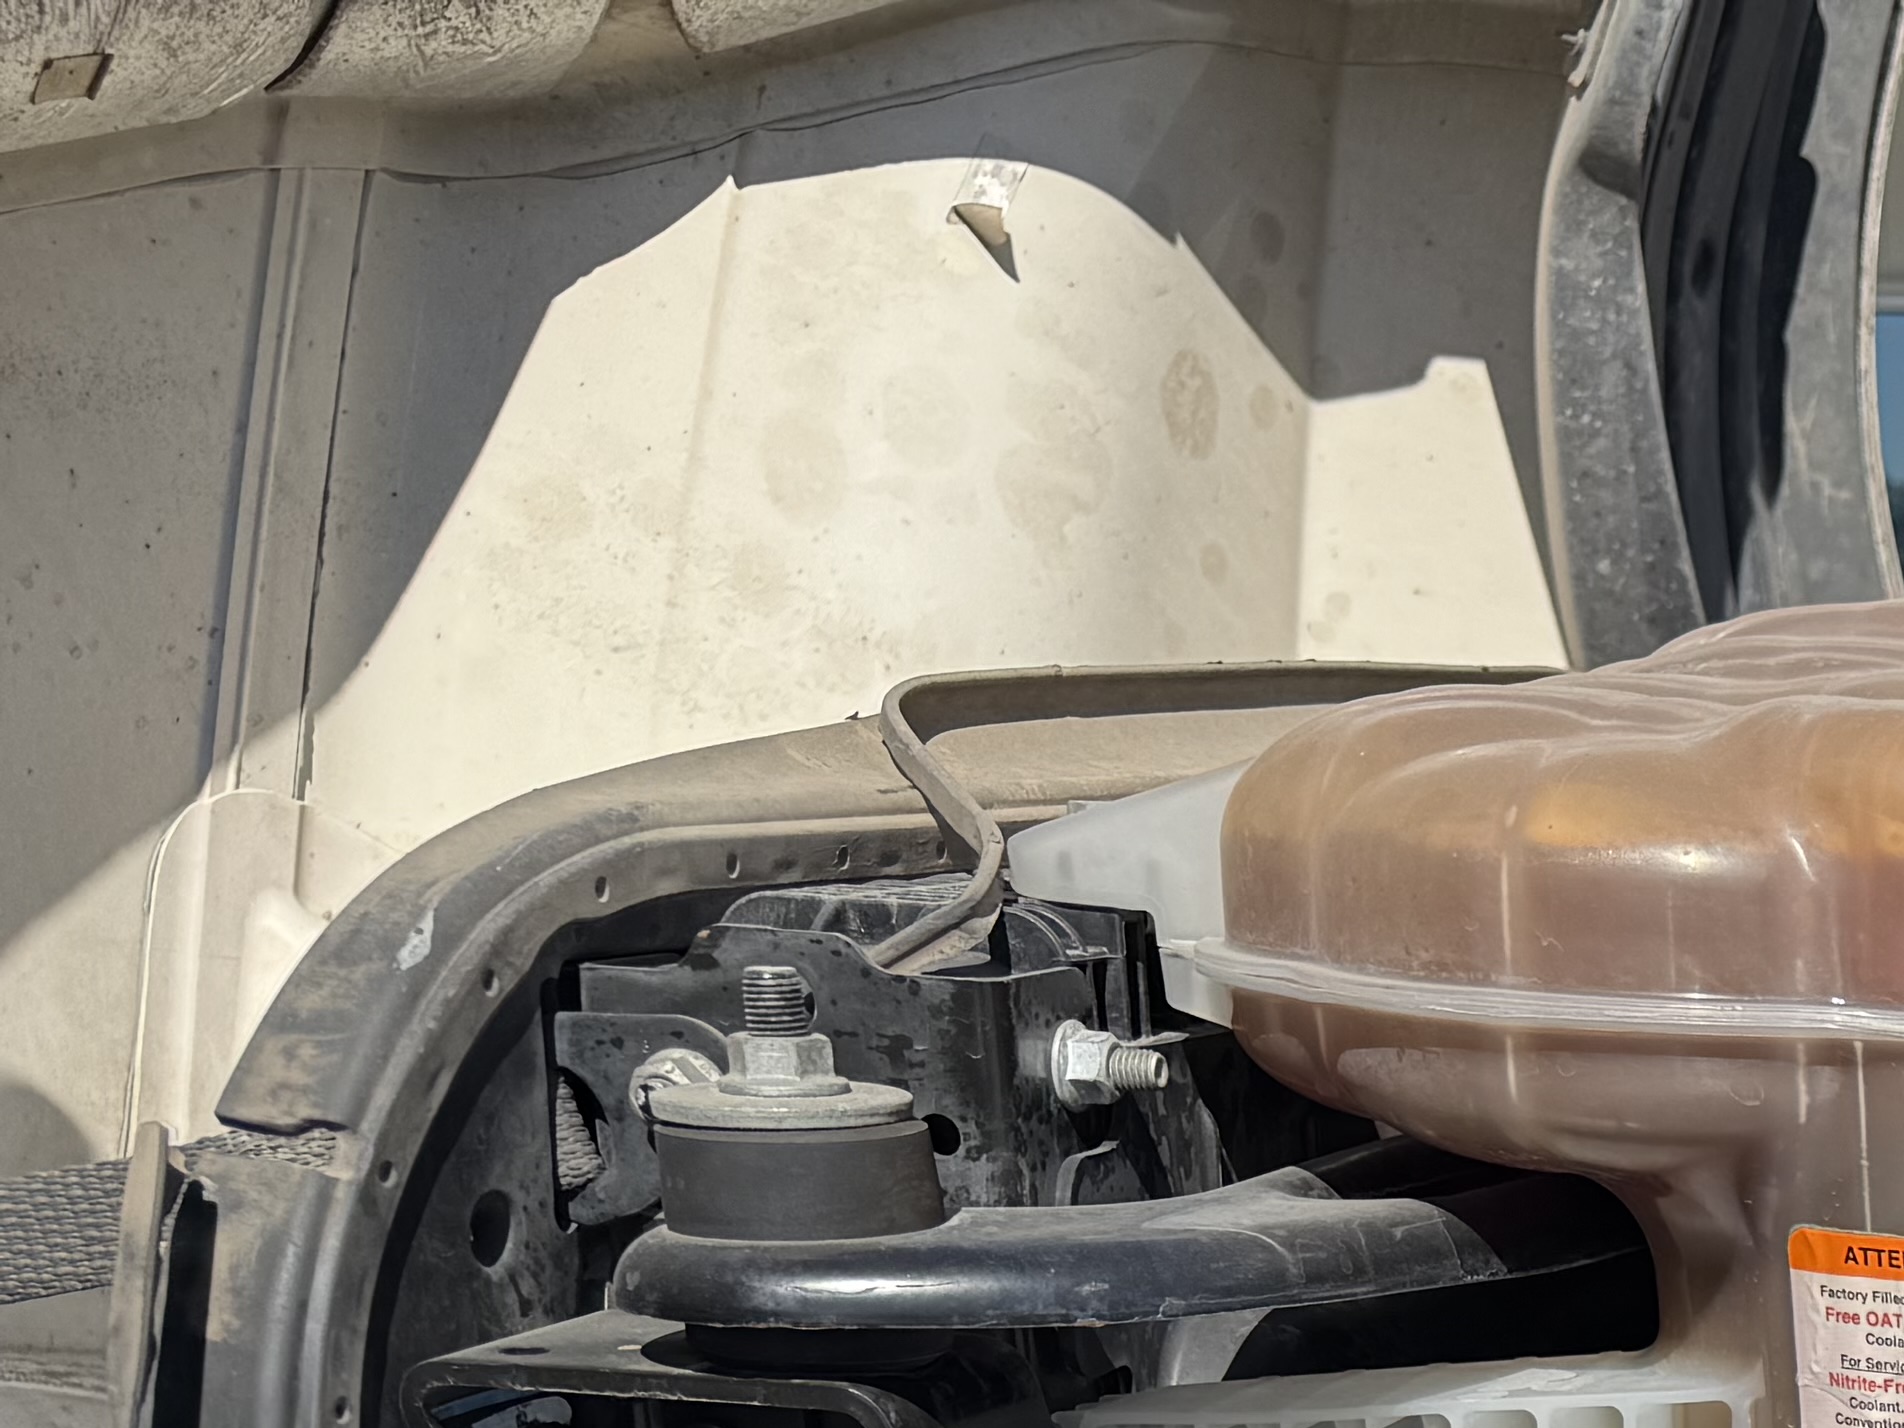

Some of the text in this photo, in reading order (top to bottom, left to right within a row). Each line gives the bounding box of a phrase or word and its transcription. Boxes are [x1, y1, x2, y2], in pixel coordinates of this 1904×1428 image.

[1820, 1285, 1868, 1304] Factory
[1825, 1307, 1861, 1327] Free
[1866, 1312, 1903, 1329] OAT
[1840, 1354, 1861, 1371] For
[1849, 1396, 1904, 1415] Coolant.
